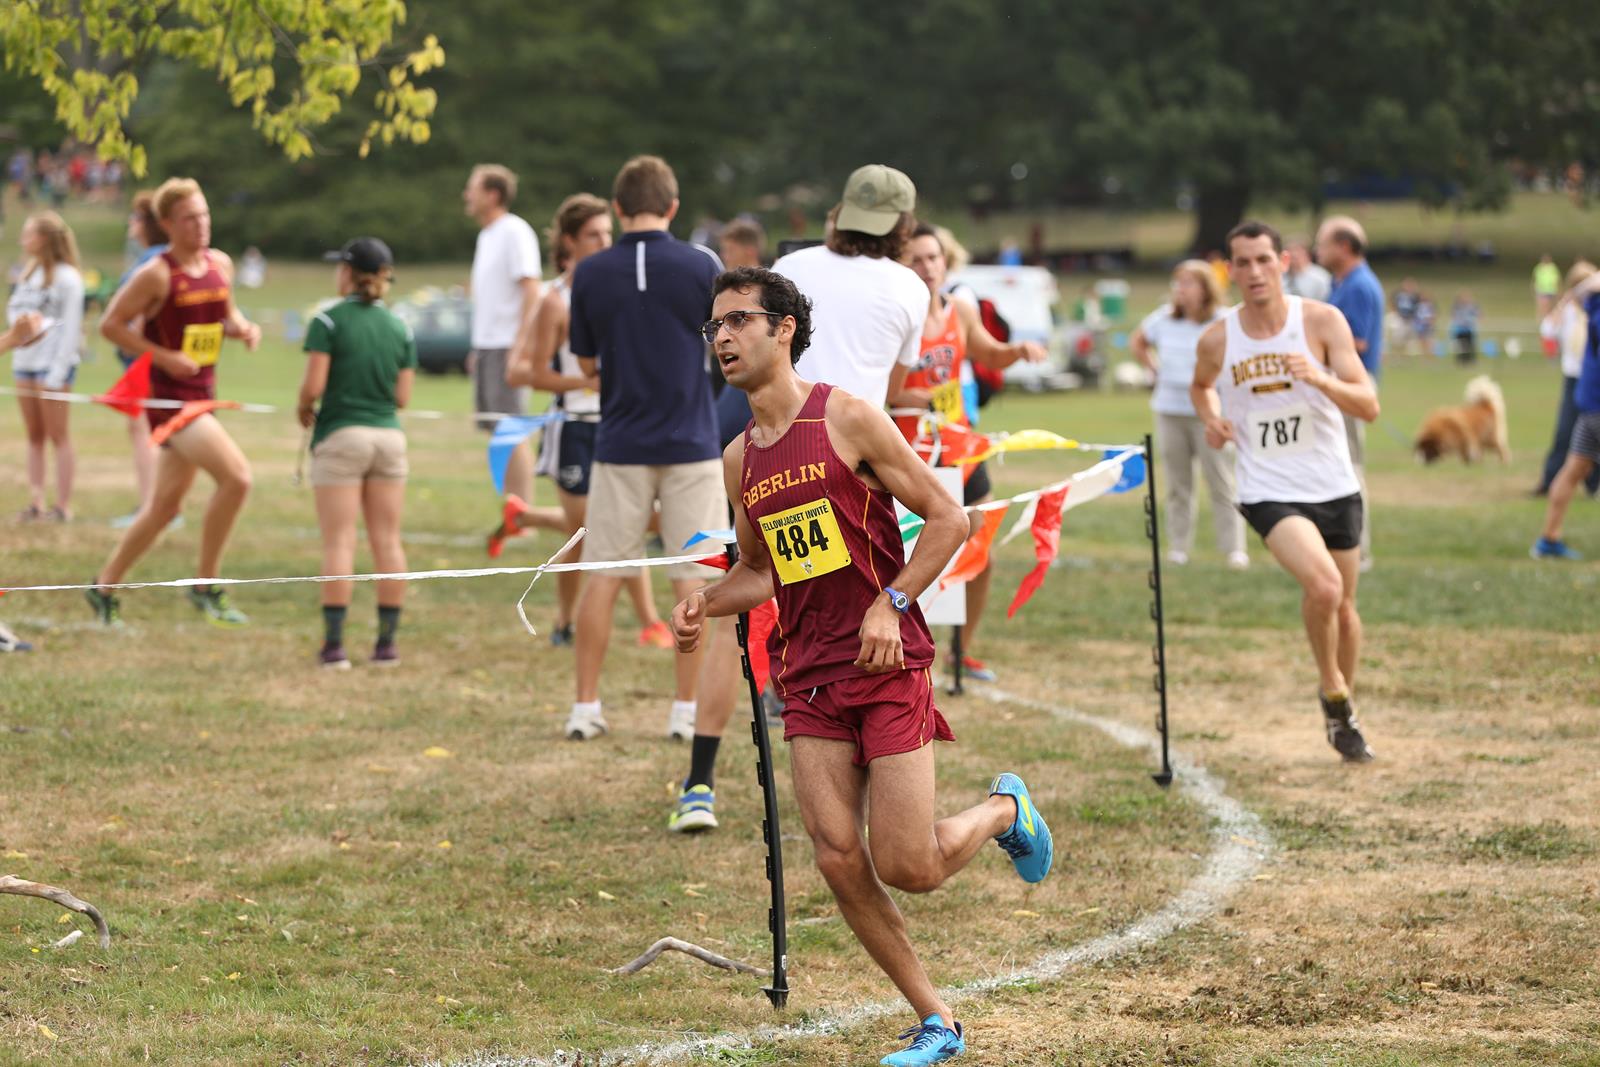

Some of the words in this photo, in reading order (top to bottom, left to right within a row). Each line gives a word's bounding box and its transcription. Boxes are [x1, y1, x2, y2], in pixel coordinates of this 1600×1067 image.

[1258, 415, 1301, 448] 787
[743, 462, 826, 508] OBERLIN
[805, 505, 829, 519] INVITE
[776, 519, 829, 561] 484
